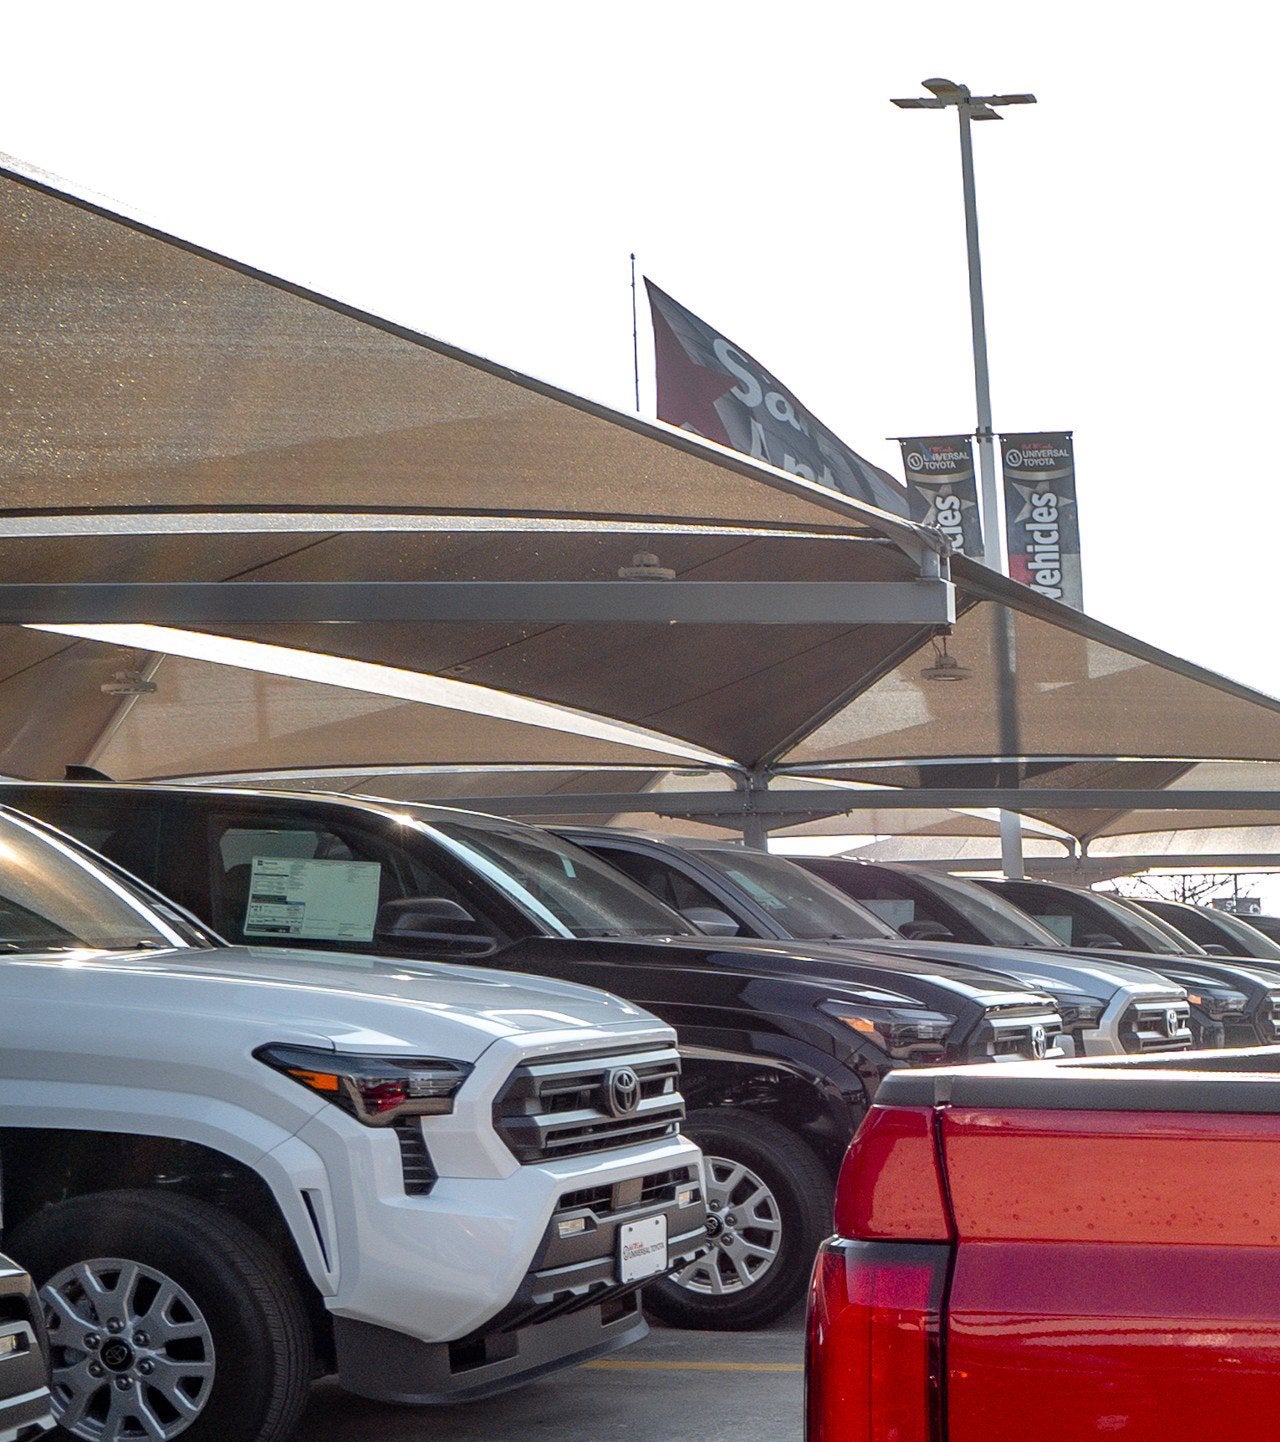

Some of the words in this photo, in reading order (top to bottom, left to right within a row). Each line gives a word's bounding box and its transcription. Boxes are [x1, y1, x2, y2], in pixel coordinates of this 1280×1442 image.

[1022, 449, 1070, 458] UNIVERSAL
[924, 461, 956, 469] TOYOTA
[1023, 458, 1056, 467] TOYOTA
